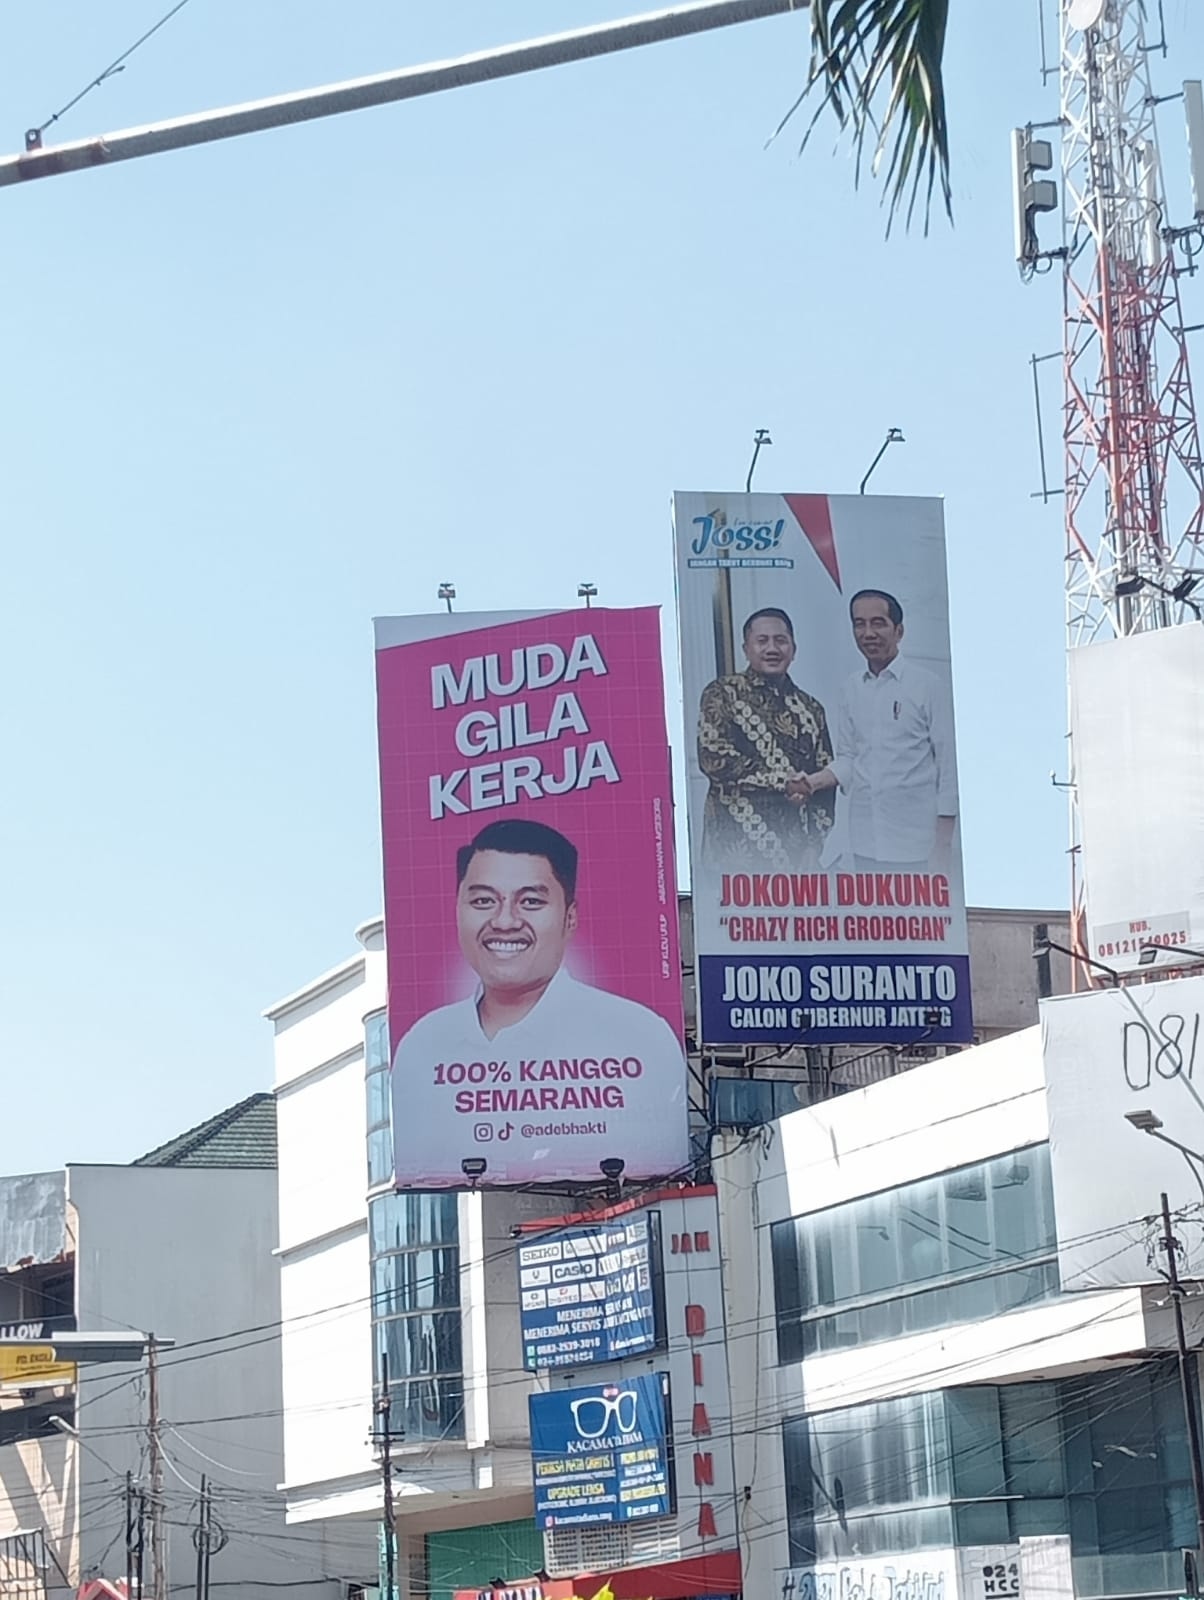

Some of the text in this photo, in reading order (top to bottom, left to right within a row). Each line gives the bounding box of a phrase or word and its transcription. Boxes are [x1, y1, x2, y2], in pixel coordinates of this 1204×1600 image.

[691, 515, 785, 555] Joss!
[430, 634, 608, 710] MUDA
[455, 692, 590, 757] GILA
[428, 740, 621, 820] KERJA
[720, 874, 950, 907] JOKOWI DUKUNG
[720, 915, 952, 942] “CRAZY RICH GROBOGAN”
[1129, 921, 1152, 934] HUB.
[723, 965, 956, 1002] JOKO SURANTO
[731, 1007, 787, 1028] CALON
[889, 1006, 952, 1027] JATEG
[434, 1057, 643, 1085] 100% KANGGO
[455, 1086, 625, 1114] SEMARANG
[522, 1246, 560, 1262] SEIKO
[671, 1231, 711, 1255] JAM
[554, 1263, 593, 1279] CASIO
[524, 1319, 602, 1340] MENERIMA SERVIS
[982, 1563, 1018, 1578] 024
[984, 1578, 1020, 1592] HCC
